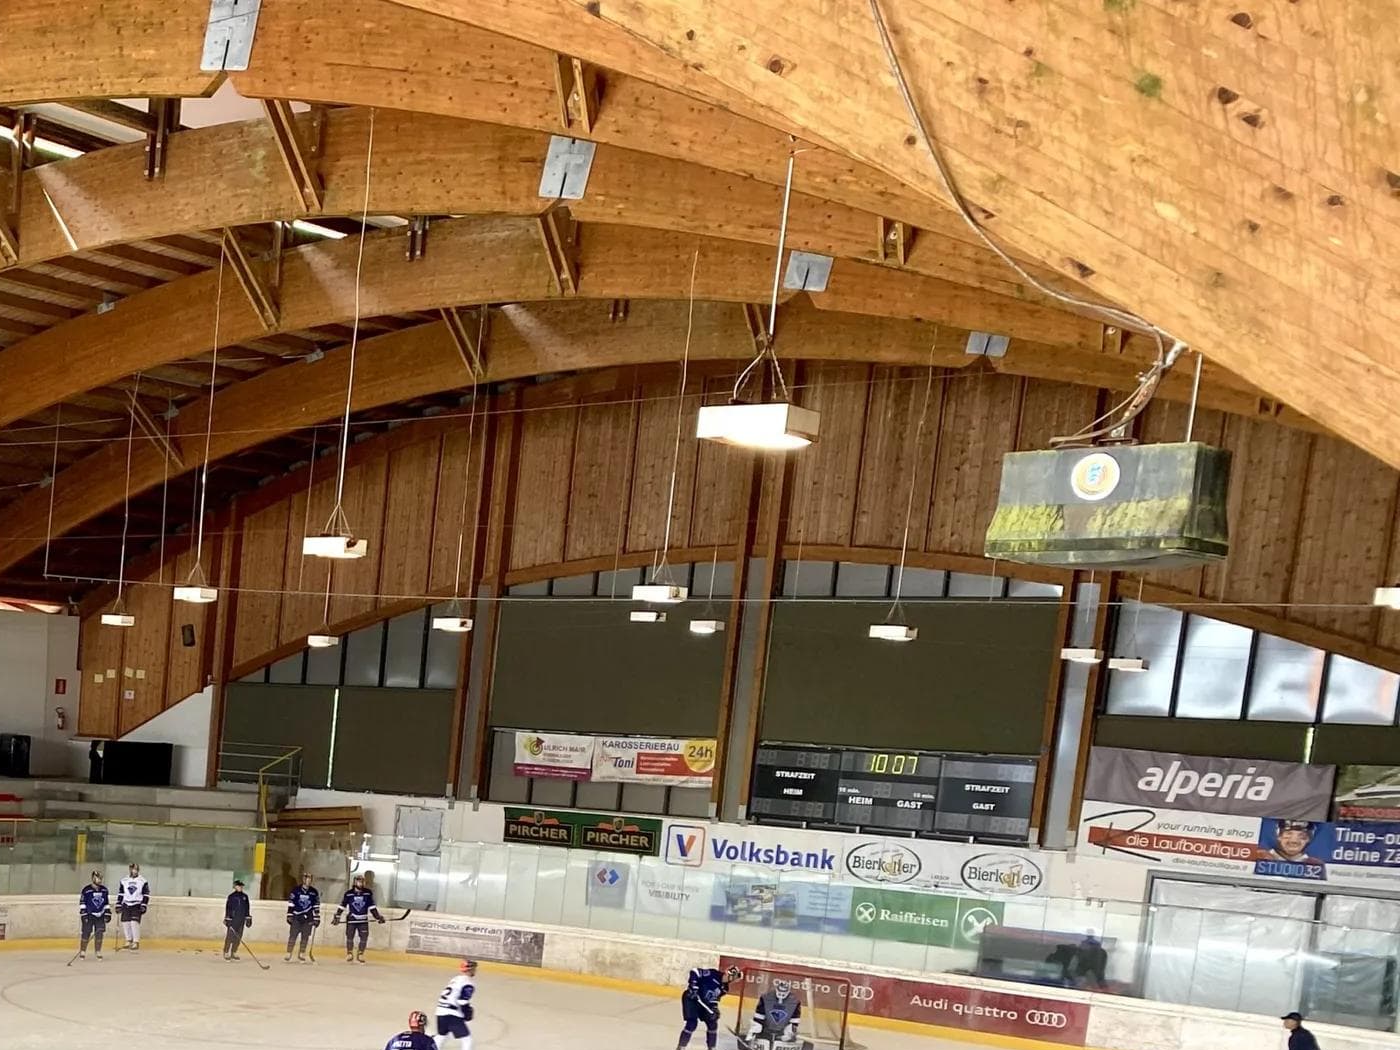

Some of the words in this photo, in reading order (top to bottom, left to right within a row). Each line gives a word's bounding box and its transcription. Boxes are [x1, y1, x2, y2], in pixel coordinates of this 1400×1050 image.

[602, 740, 680, 751] KAROSSERIEBAU
[688, 745, 713, 758] 24h
[613, 756, 635, 769] Toni
[775, 770, 817, 780] STRAFZEIT
[1137, 761, 1274, 803] alperia
[783, 787, 804, 796] HEIM
[964, 784, 1011, 794] STRAFZEIT
[848, 796, 873, 805] HEIM
[896, 800, 923, 810] GAST
[972, 802, 996, 811] GAST
[509, 824, 568, 840] PIRCHER
[1157, 822, 1181, 831] your
[1183, 824, 1225, 837] running
[1226, 828, 1254, 838] shop
[586, 829, 649, 847] PIRCHER
[1126, 834, 1149, 848] die
[1153, 836, 1251, 859] Laufboutique
[711, 838, 835, 871] Volksbank
[1332, 846, 1380, 863] deine
[879, 908, 949, 928] Raiffeisen
[910, 994, 949, 1010] Audi
[952, 1002, 1018, 1021] quattro
